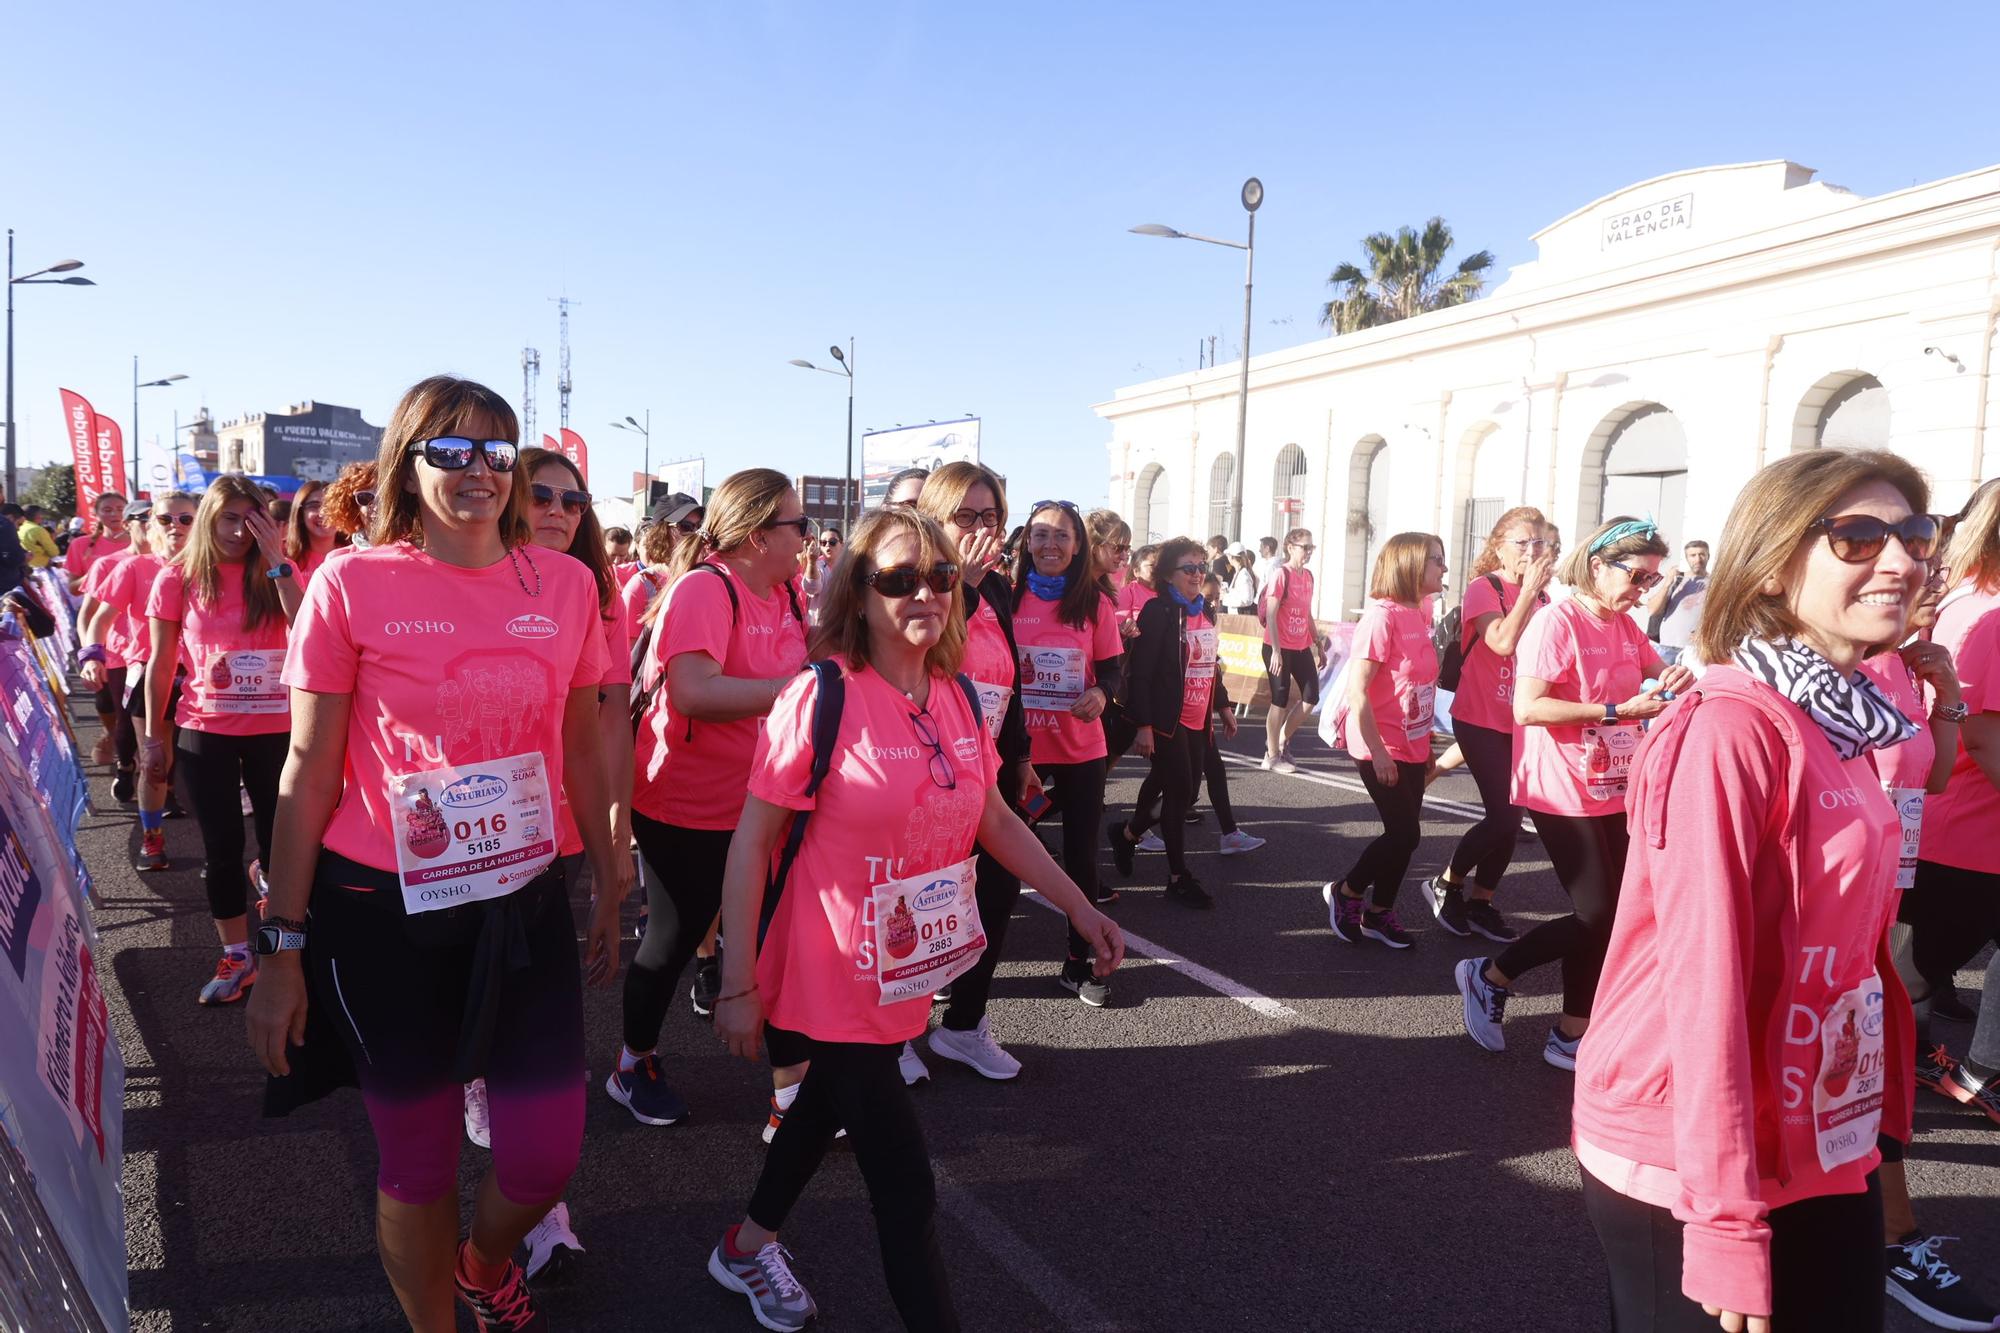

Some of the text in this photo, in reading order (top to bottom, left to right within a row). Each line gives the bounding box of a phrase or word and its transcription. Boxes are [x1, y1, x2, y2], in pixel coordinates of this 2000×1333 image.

[1611, 200, 1684, 230] GRAO DE
[1607, 214, 1685, 244] VALENCIA
[284, 426, 317, 436] PUERTO
[385, 620, 455, 636] OYSHO
[511, 624, 555, 633] ASTURIANA
[234, 675, 263, 685] 016
[1037, 671, 1061, 682] 016
[397, 732, 444, 764] TU
[868, 745, 920, 760] OYSHO
[512, 770, 537, 782] SUMA
[446, 785, 504, 803] ASTURIANA
[453, 813, 507, 841] 016
[467, 838, 501, 856] 5185
[422, 845, 544, 880] CARRERA DE LA MUJER 2023
[864, 856, 904, 882] TU
[420, 883, 471, 902] OYSHO
[917, 888, 957, 908] ASTURIANA
[921, 914, 958, 940] 016
[929, 937, 952, 954] 2883
[895, 947, 968, 978] CARRERA DE LA MUJER
[893, 979, 929, 997] OYSHO
[1785, 1004, 1820, 1046] D
[1782, 1066, 1806, 1110] S
[1825, 1131, 1857, 1154] OYSHO
